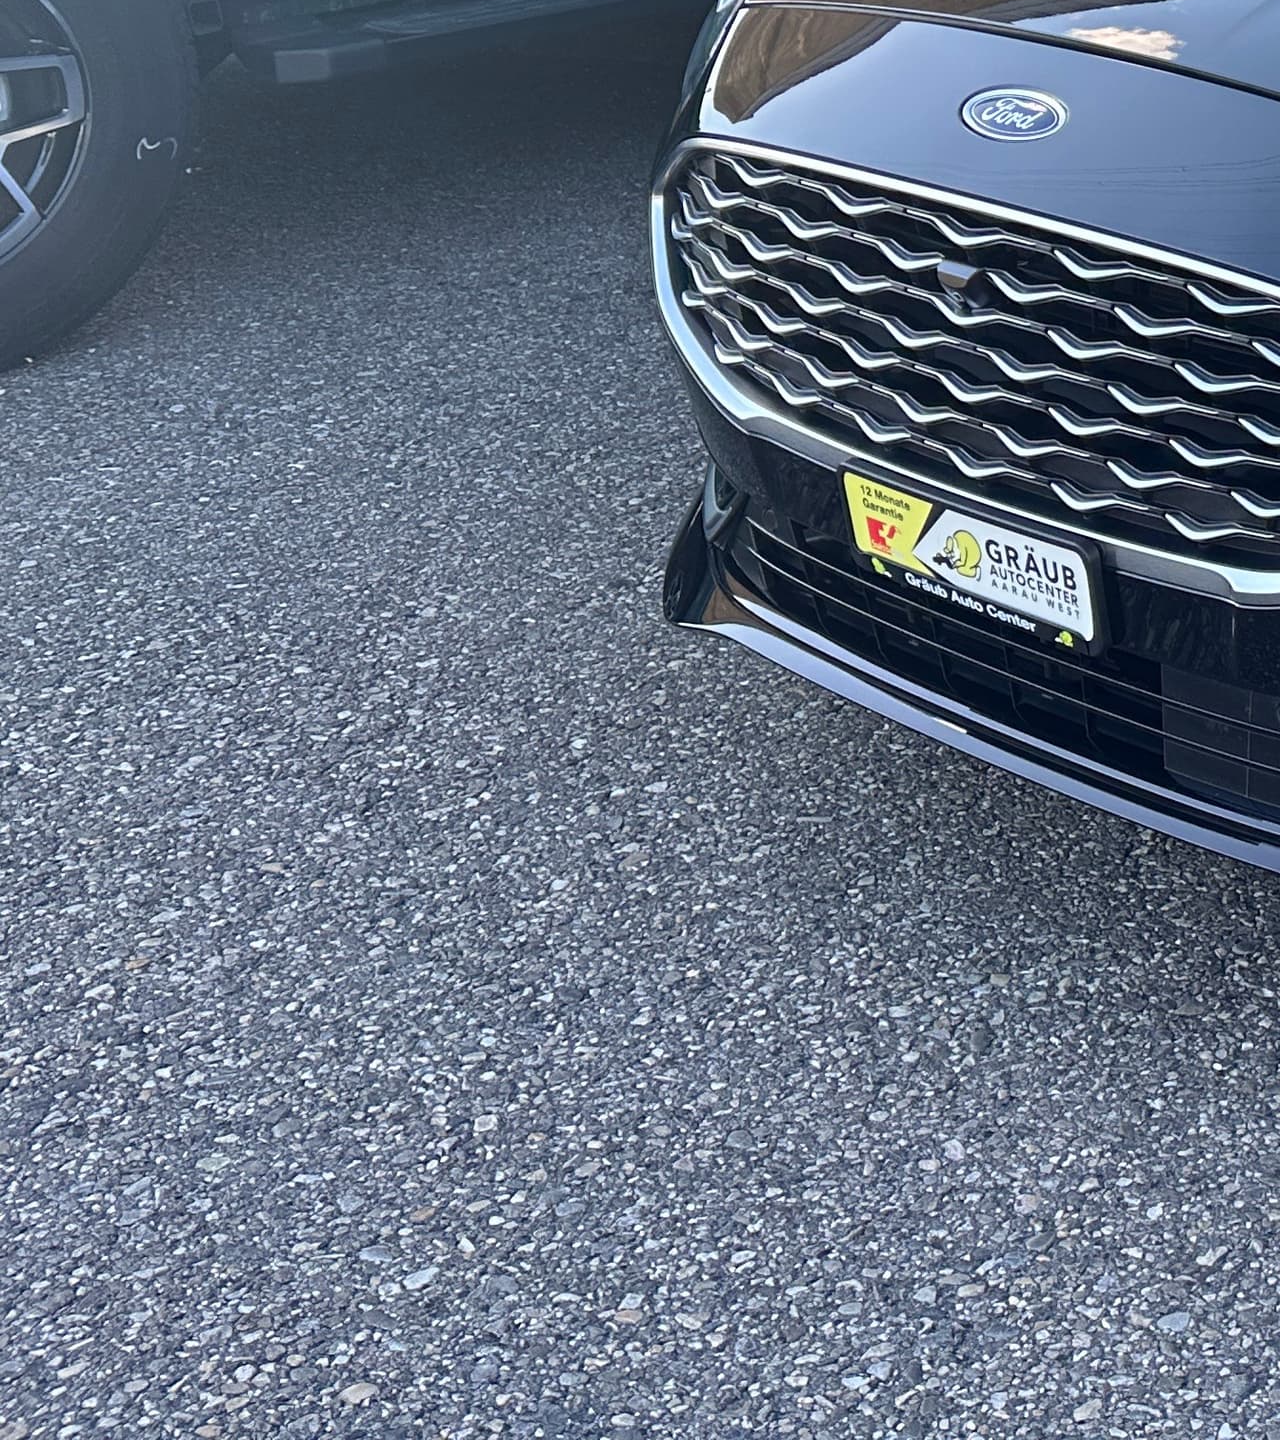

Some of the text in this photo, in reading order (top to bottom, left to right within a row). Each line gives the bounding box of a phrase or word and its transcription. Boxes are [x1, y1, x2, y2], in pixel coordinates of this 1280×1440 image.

[981, 97, 1048, 130] Ford
[860, 485, 911, 511] 12 Monate
[862, 497, 904, 521] Garantie
[984, 539, 1077, 591] GRÄUB
[989, 564, 1079, 606] AUTOCENTER
[904, 571, 1036, 633] Gräub Auto Center
[991, 579, 1080, 620] AARAU WEST
